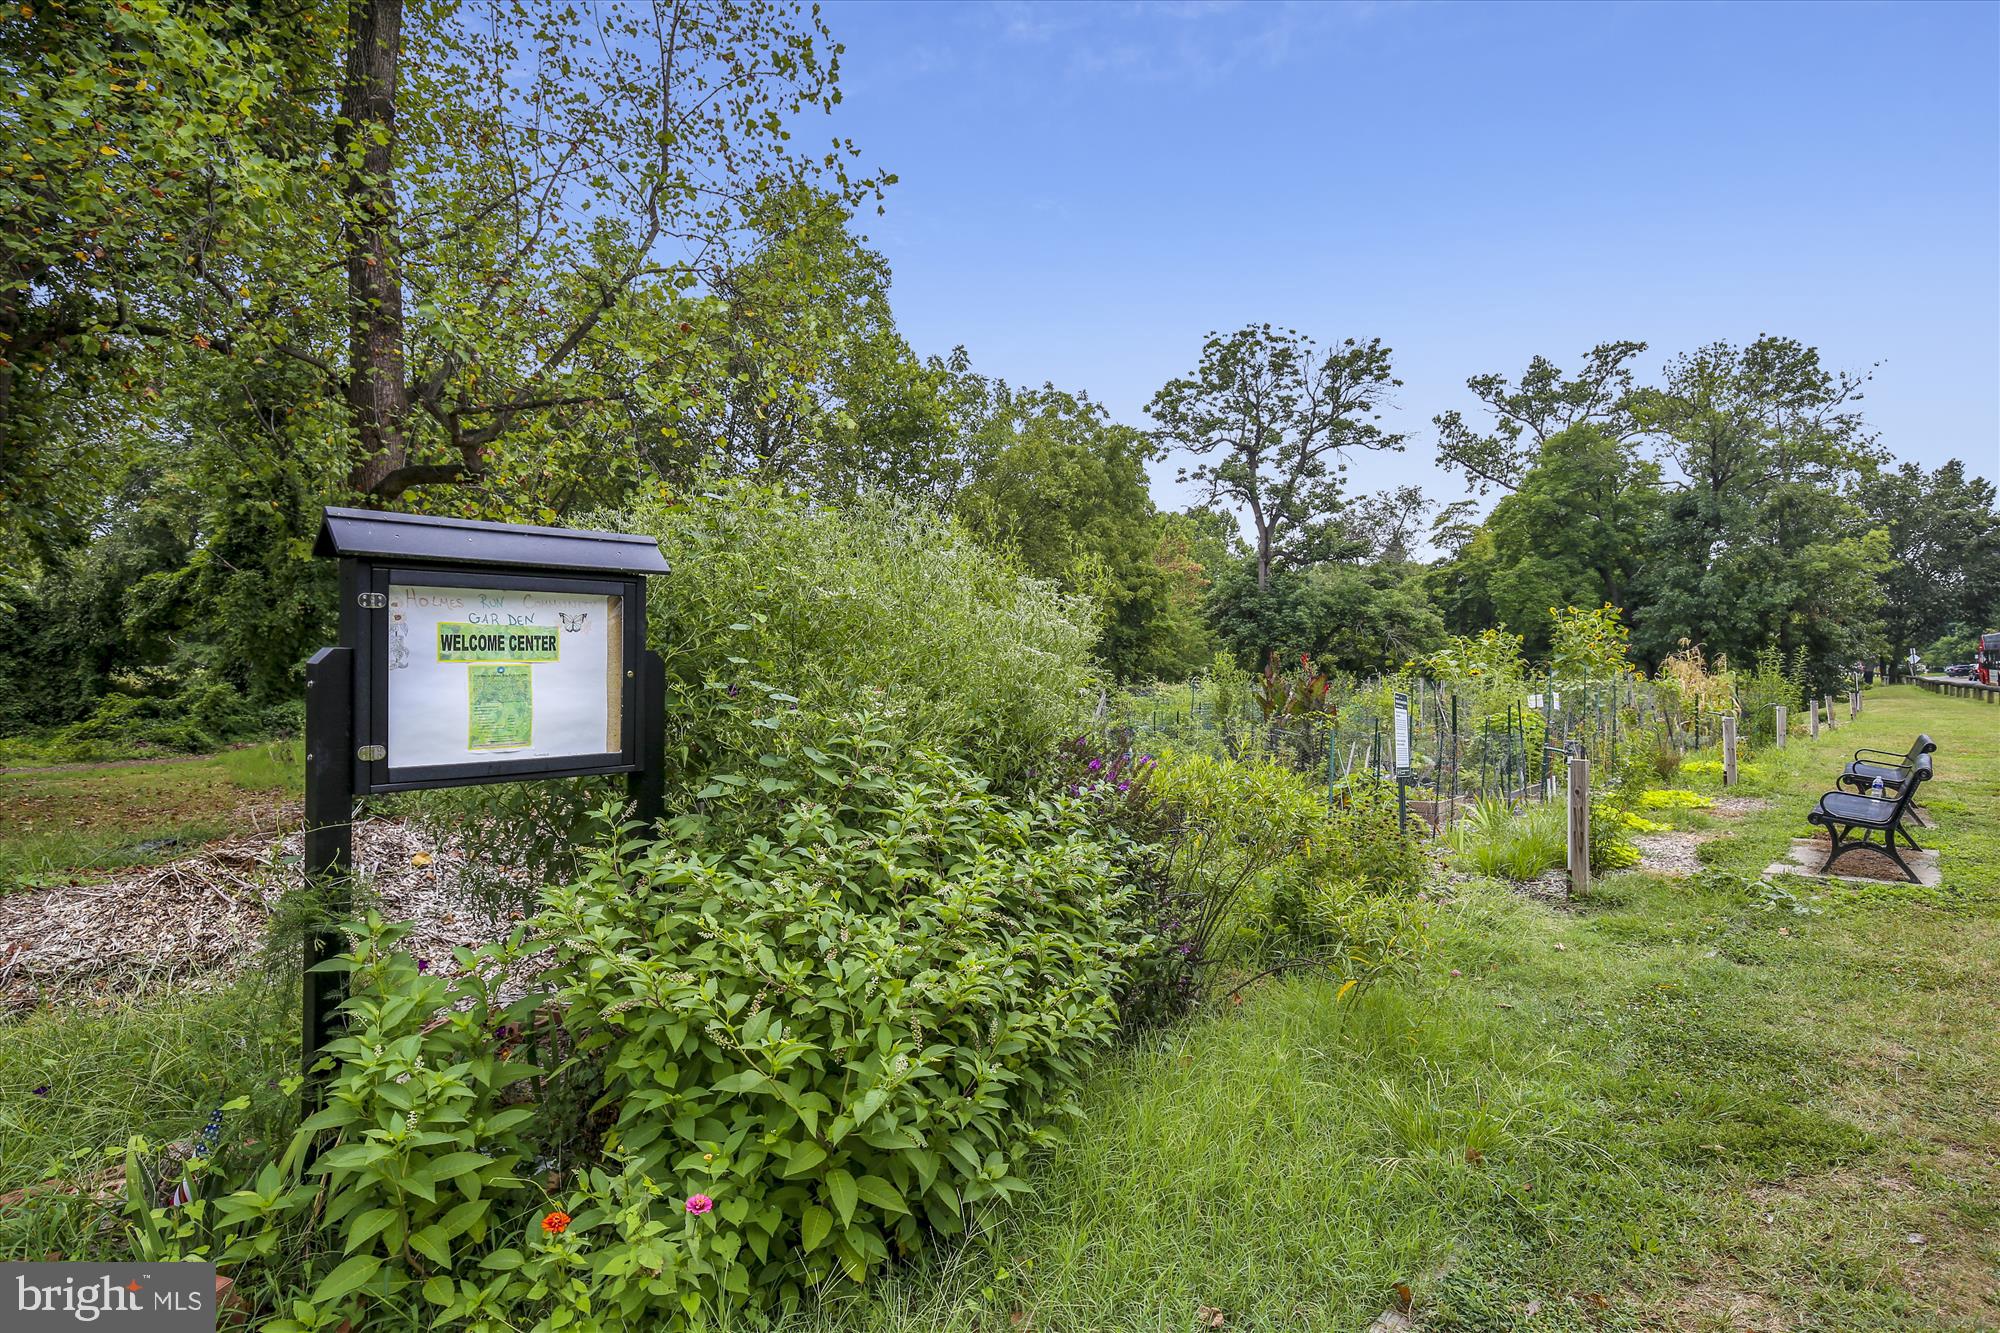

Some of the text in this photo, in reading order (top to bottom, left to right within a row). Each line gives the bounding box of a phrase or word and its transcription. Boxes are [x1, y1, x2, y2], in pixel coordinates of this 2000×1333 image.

[405, 588, 464, 609] HOLMES
[479, 594, 504, 609] RUN
[441, 634, 557, 652] WELCOME CENTER
